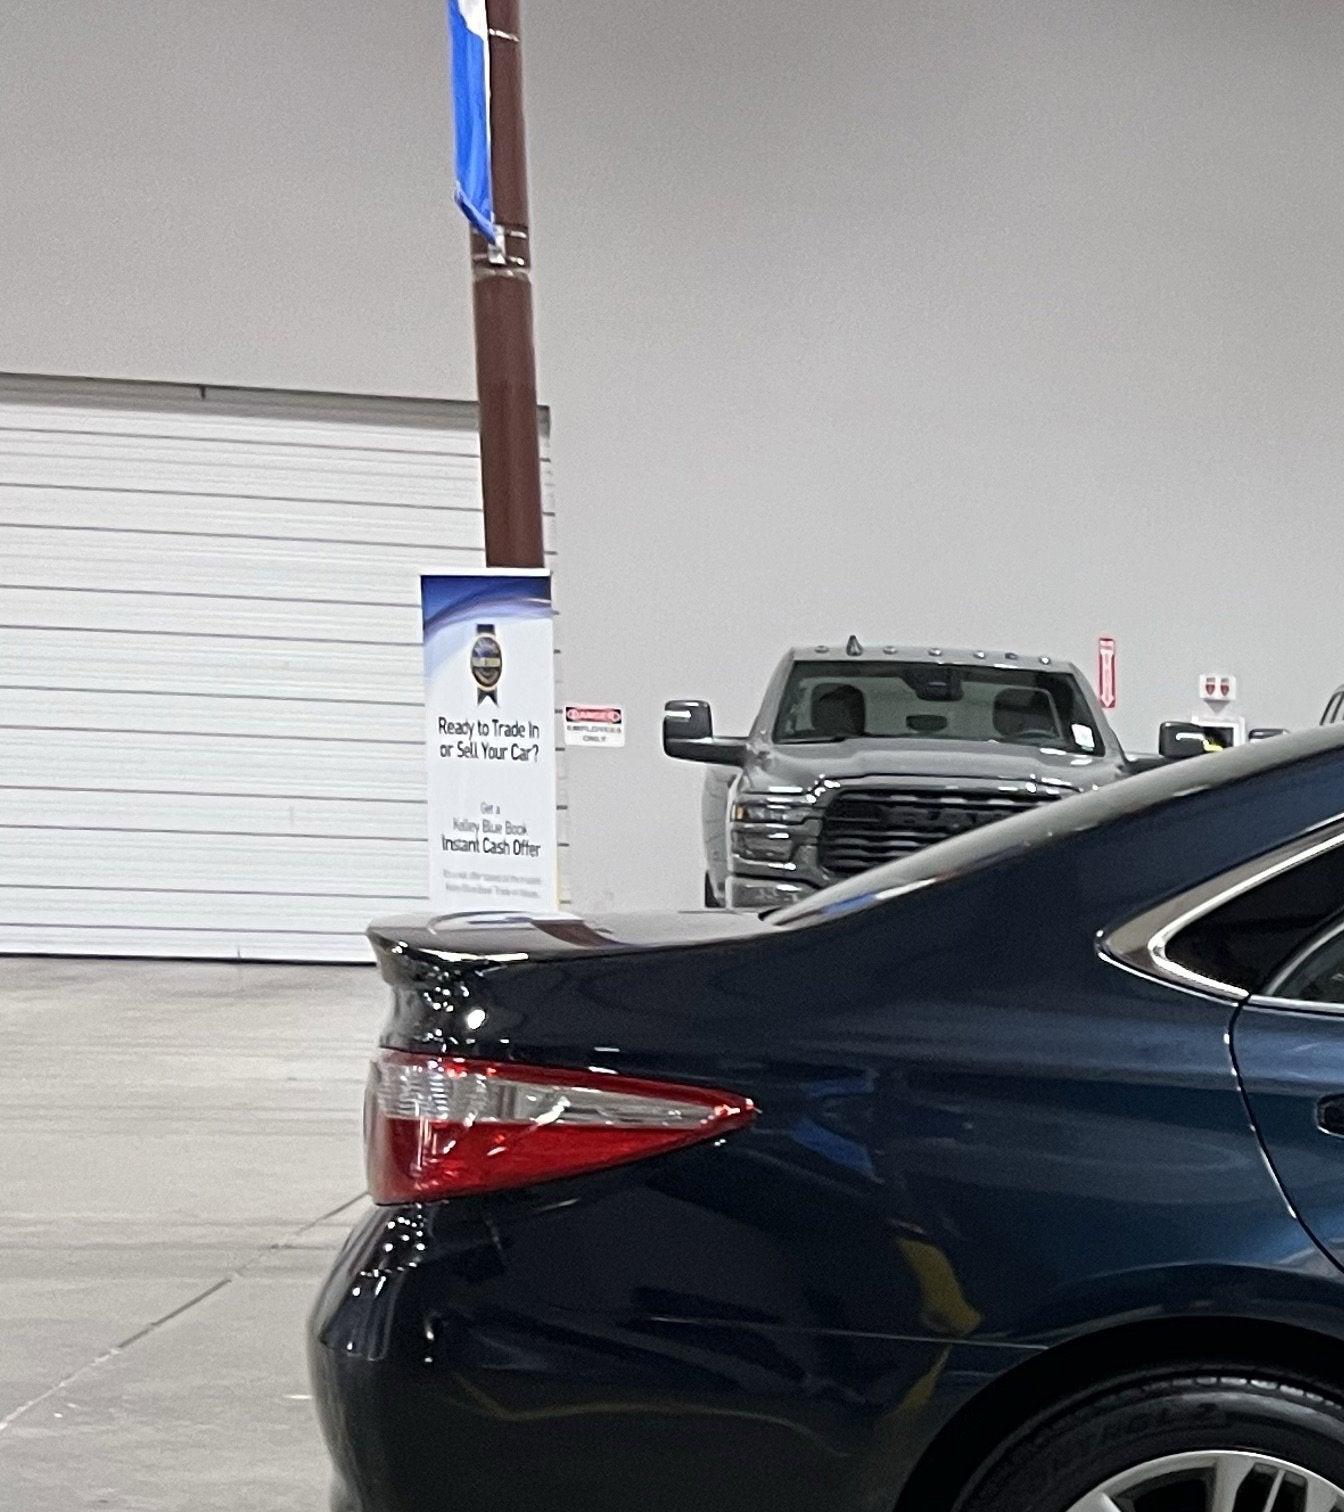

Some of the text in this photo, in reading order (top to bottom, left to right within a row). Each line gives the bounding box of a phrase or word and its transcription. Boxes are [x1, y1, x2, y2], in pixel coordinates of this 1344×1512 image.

[438, 716, 540, 740] Ready to Trade In
[440, 741, 540, 762] or Sell Your Car?
[482, 819, 502, 835] Blue
[482, 836, 511, 855] Cash
[512, 839, 541, 857] Offer
